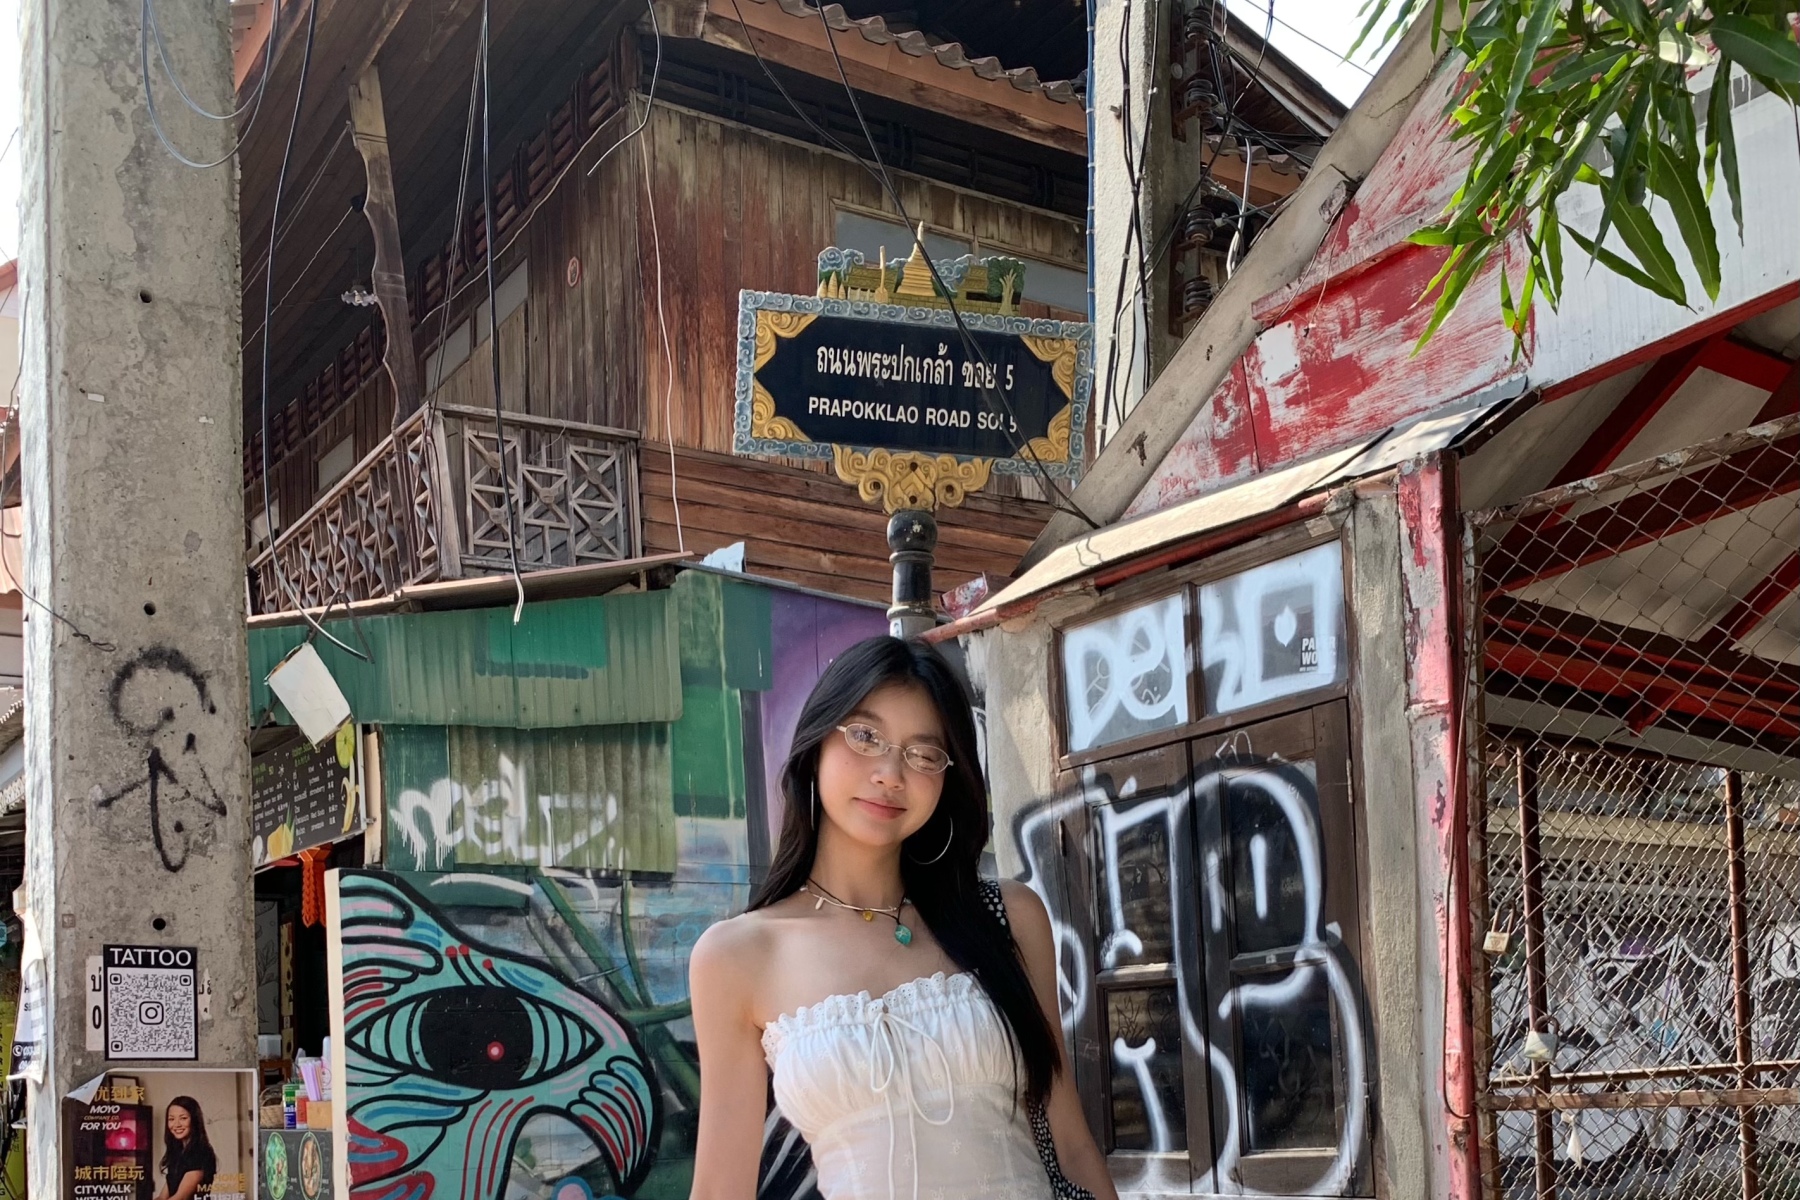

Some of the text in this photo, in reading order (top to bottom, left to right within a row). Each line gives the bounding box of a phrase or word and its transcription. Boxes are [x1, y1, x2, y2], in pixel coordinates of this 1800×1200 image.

[816, 342, 1014, 391] ถนนพระปกเกล้า ซอย 5
[808, 397, 919, 424] PRAPOKKLAO
[925, 407, 971, 428] ROAD
[1009, 415, 1018, 433] 5
[110, 948, 191, 966] TATTOO
[94, 1086, 144, 1101] 优到家
[90, 1105, 120, 1114] MOYO
[80, 1122, 121, 1131] FOR YOU
[74, 1165, 144, 1181] 城市陪玩
[214, 1173, 246, 1182] HOME
[74, 1184, 131, 1195] CITYWALK
